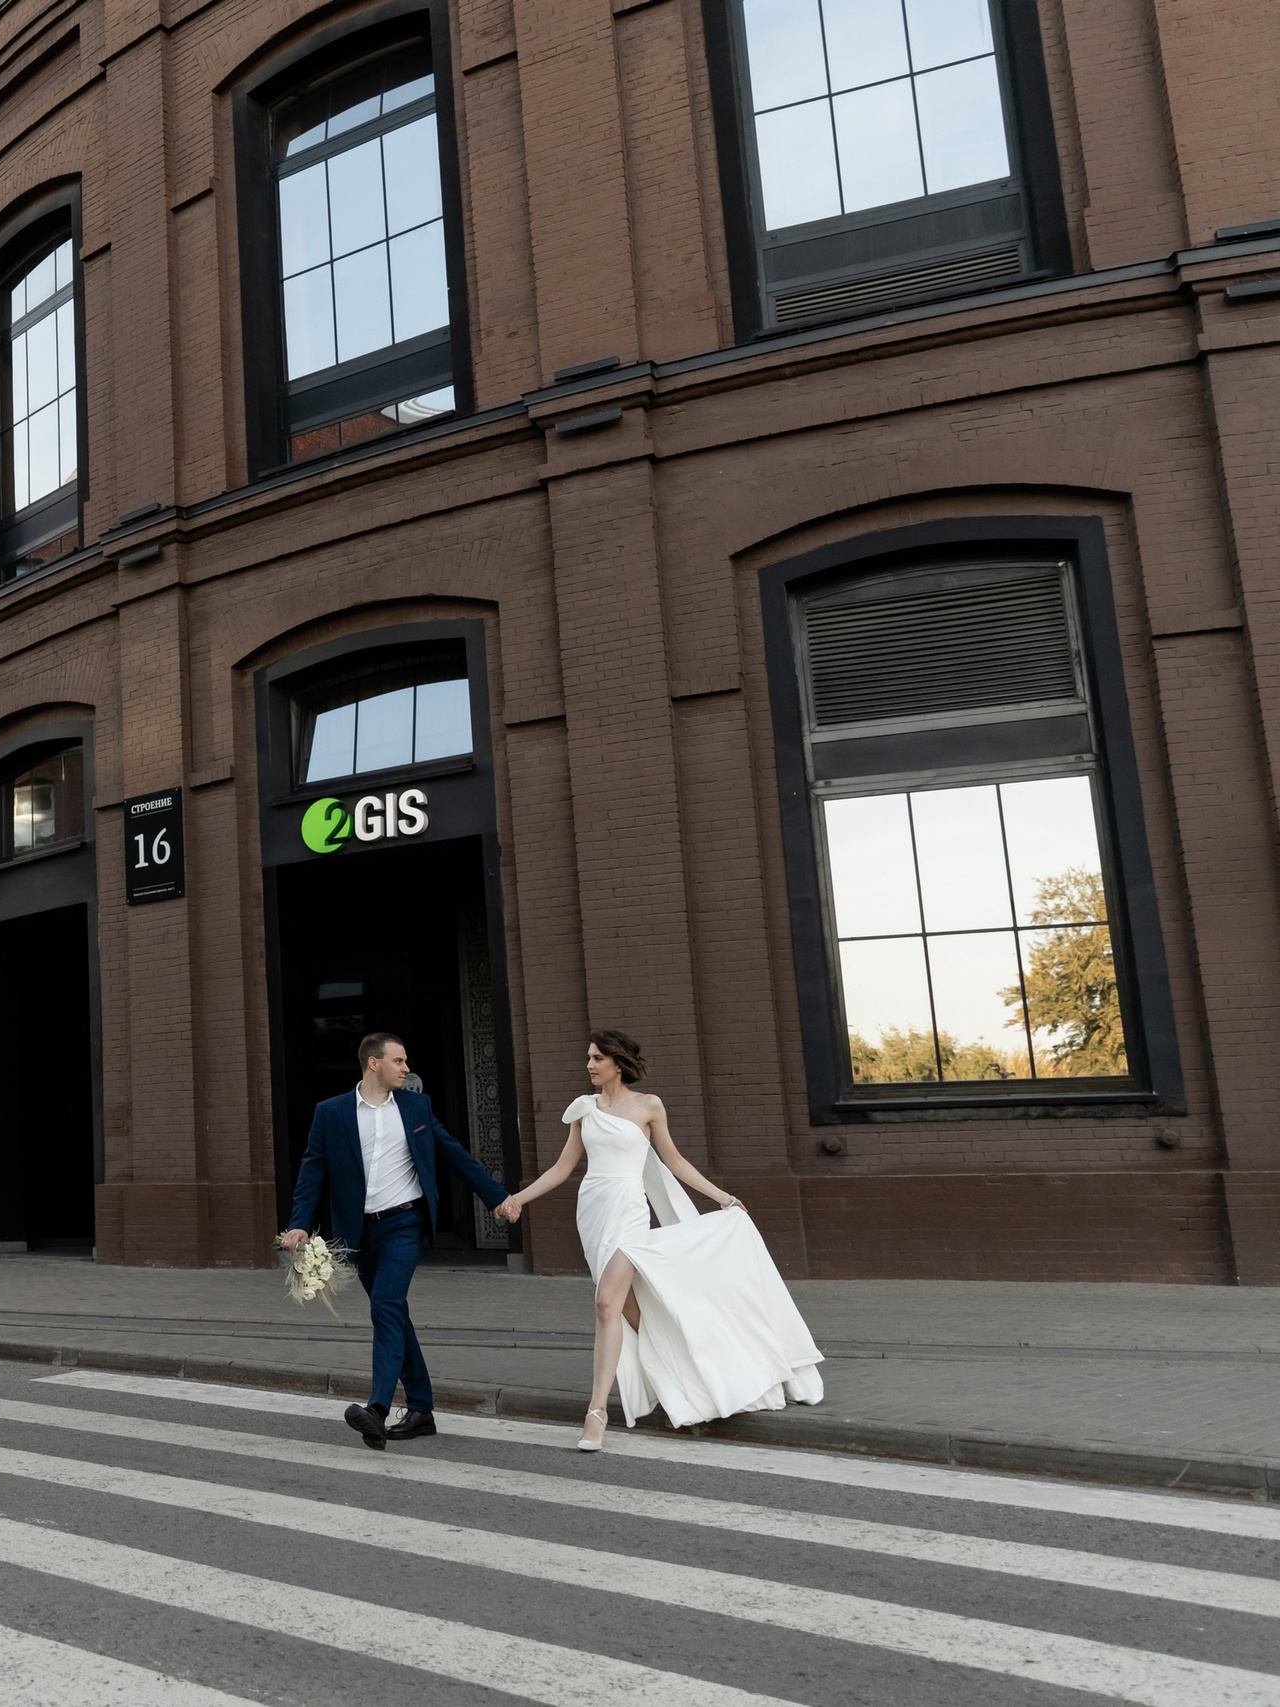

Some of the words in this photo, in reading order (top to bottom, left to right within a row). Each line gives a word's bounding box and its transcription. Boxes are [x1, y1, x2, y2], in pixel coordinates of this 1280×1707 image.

[131, 797, 173, 814] СТРОЕНИЕ
[308, 789, 429, 851] 2GIS
[134, 827, 171, 869] 16
